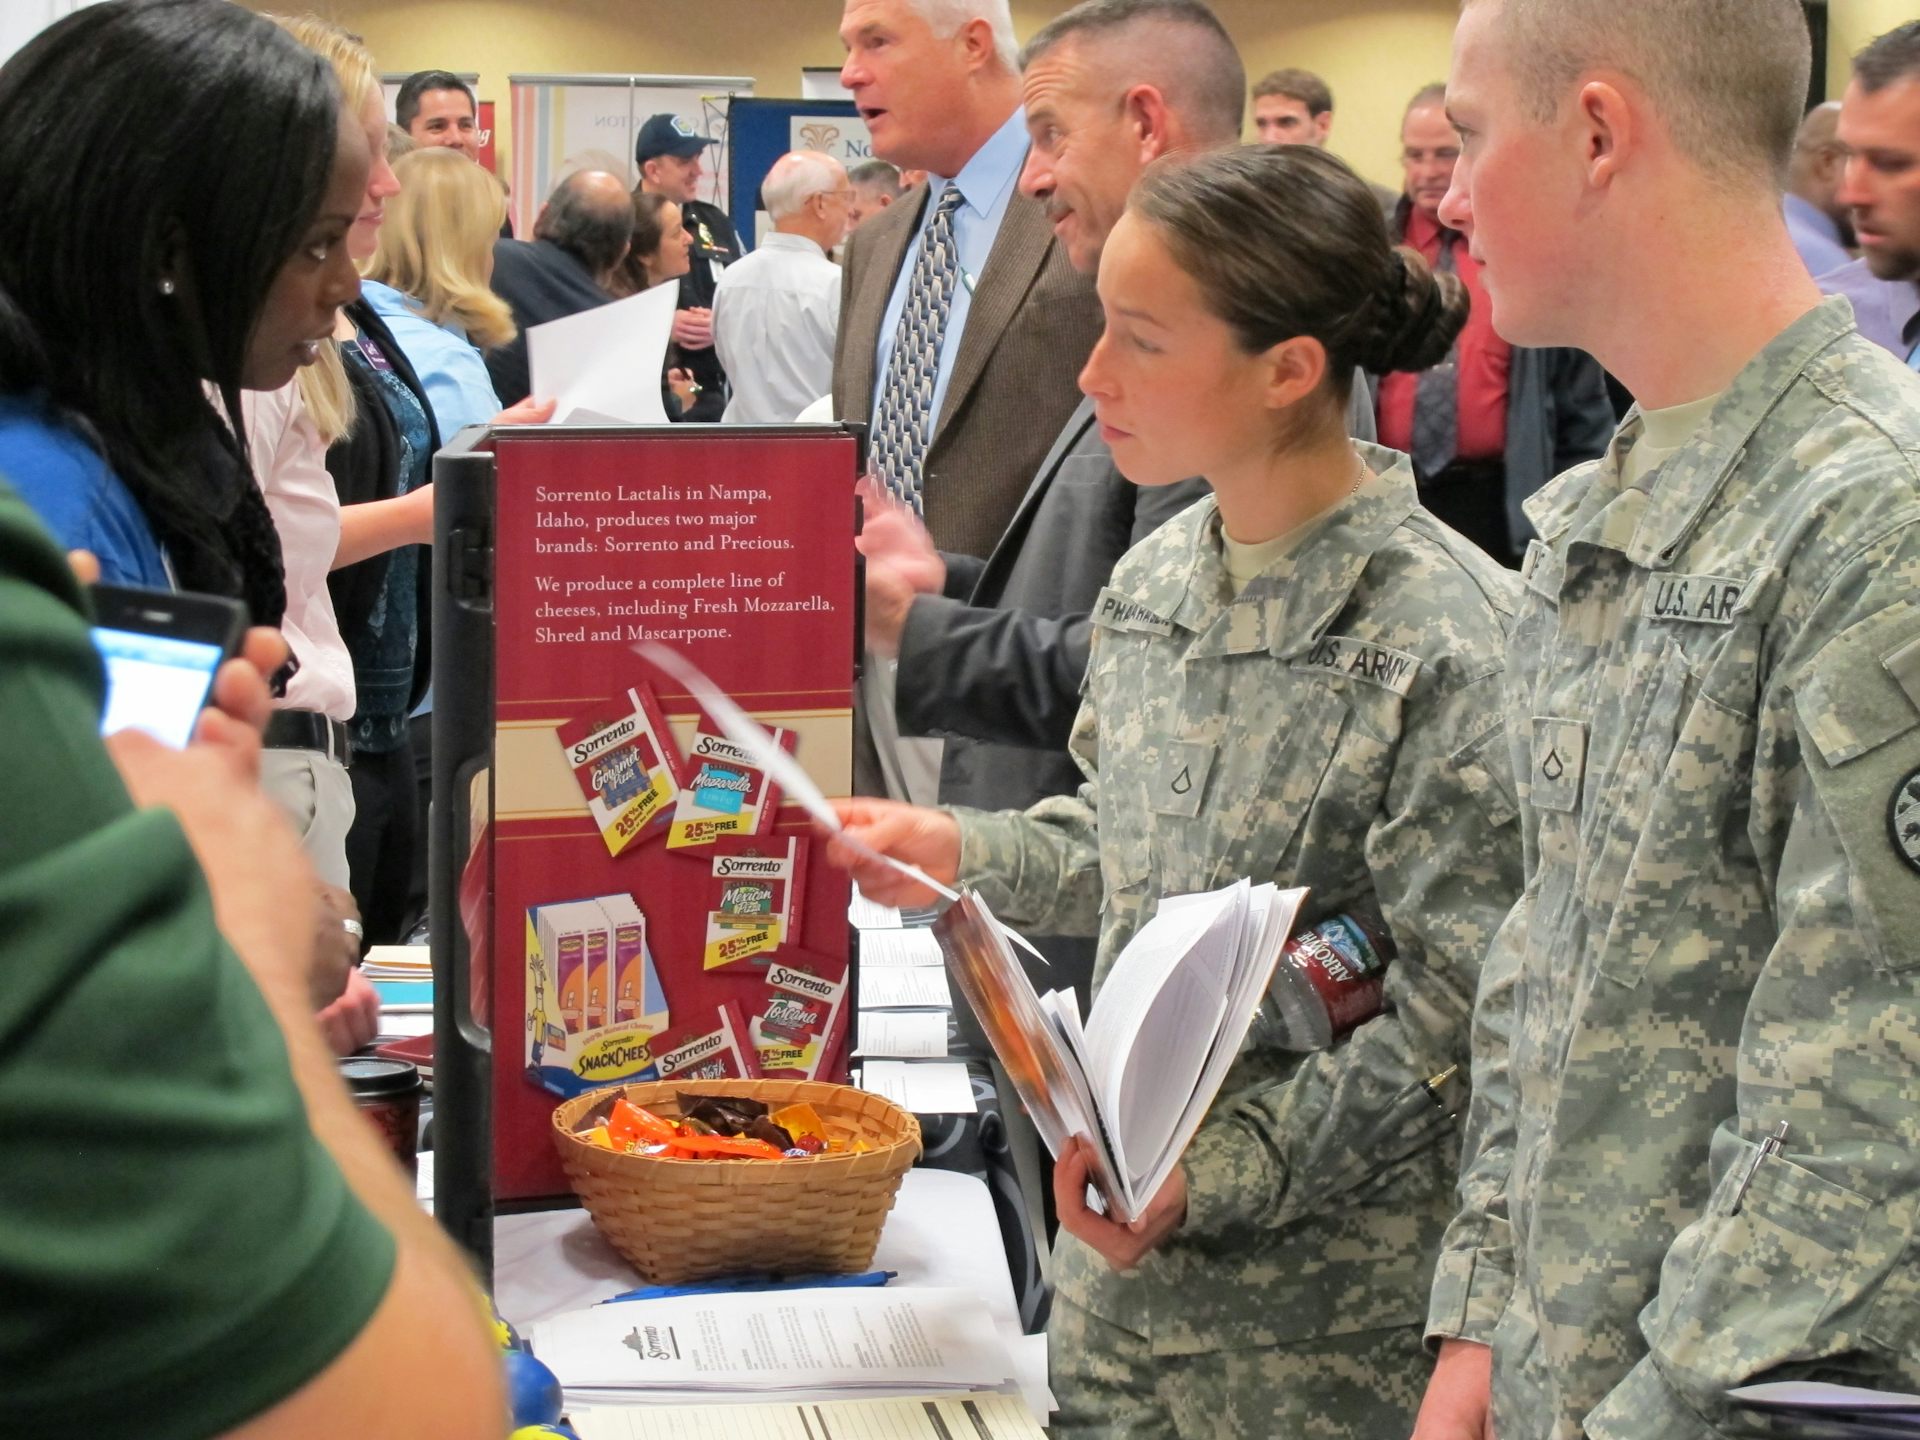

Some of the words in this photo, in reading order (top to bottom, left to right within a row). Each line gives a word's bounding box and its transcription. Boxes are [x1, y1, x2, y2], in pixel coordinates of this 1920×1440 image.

[845, 139, 873, 158] No
[535, 486, 612, 502] Sorrento
[617, 484, 681, 501] Lactalis
[686, 486, 704, 500] in
[709, 484, 772, 504] Nampa,
[536, 511, 589, 528] Idaho,
[595, 510, 671, 533] produces
[675, 514, 704, 526] two
[709, 511, 758, 531] major
[535, 536, 598, 554] brands:
[604, 535, 679, 552] Sorrento
[683, 534, 715, 551] and
[720, 534, 795, 550] Precious.
[534, 576, 560, 592] We
[565, 574, 634, 597] produce
[638, 579, 647, 590] a
[651, 572, 726, 594] complete
[730, 572, 763, 588] line
[767, 571, 786, 587] of
[535, 601, 601, 618] cheeses,
[607, 599, 689, 620] including
[693, 597, 738, 614] Fresh
[744, 595, 835, 613] Mozzarella,
[1655, 581, 1688, 616] U.S.
[1697, 584, 1740, 620] AR
[535, 626, 585, 643] Shred
[590, 625, 622, 642] and
[627, 624, 732, 644] Mascarpone.
[1309, 641, 1340, 669] U.S.
[1348, 647, 1409, 686] ARMY
[574, 720, 635, 764] Sorrento
[592, 746, 640, 791] Gourmet
[690, 772, 752, 792] Mozzarella
[638, 788, 659, 811] FREE
[715, 820, 738, 831] FREE
[717, 858, 781, 876] Sorrento
[720, 888, 772, 908] Mexican
[746, 931, 769, 946] FREE
[771, 968, 832, 995] Sorrento
[763, 998, 818, 1025] Toscana
[601, 1035, 635, 1051] Sorrento
[662, 1033, 722, 1073] Sorrento
[781, 1049, 803, 1059] FREE
[644, 1326, 670, 1360] Sorrento
